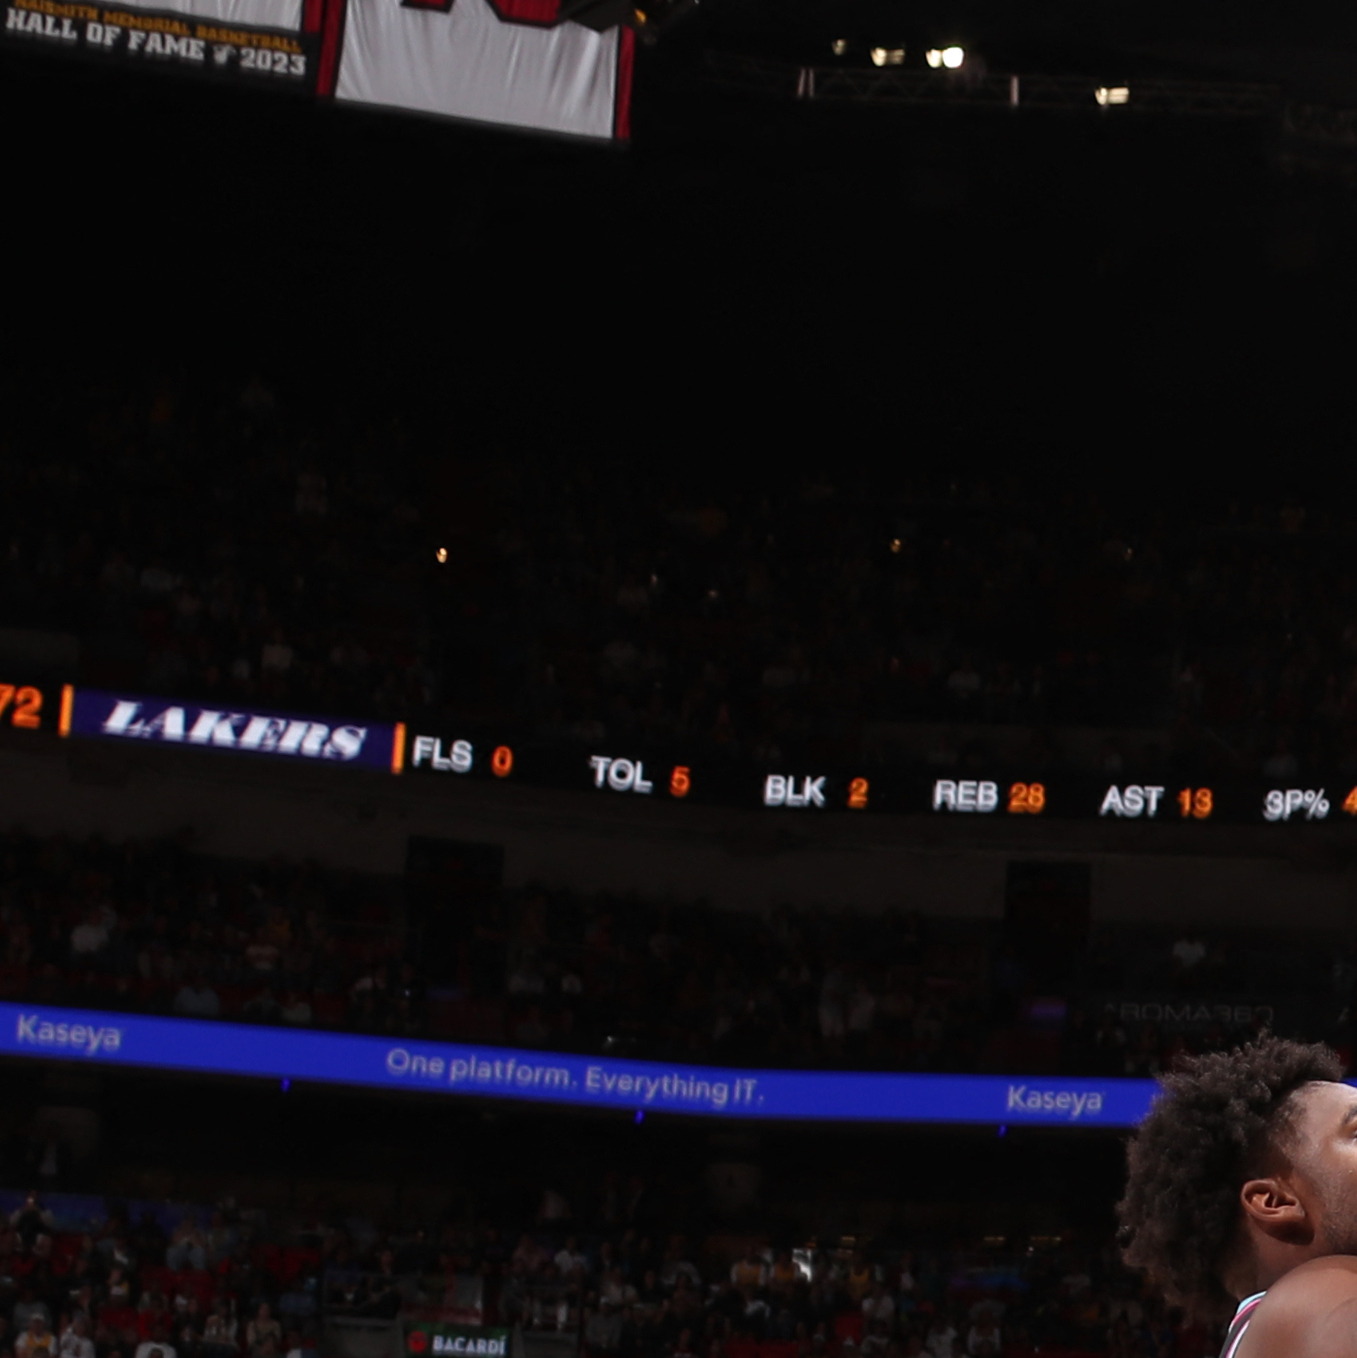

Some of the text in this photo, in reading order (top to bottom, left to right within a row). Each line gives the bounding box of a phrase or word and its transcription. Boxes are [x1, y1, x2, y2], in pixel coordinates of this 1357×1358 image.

[6, 7, 306, 75] HALL OF FAME 2023
[103, 699, 367, 760] LAKERS
[413, 736, 512, 776] FLS 0
[591, 755, 689, 796] TOL 5
[764, 775, 867, 807] BLK 2
[934, 780, 1045, 814] REB 28
[1101, 787, 1163, 817] AST
[17, 1014, 122, 1054] Kaseya
[387, 1047, 444, 1079] One
[450, 1052, 578, 1091] platform.
[586, 1066, 729, 1107] Everything
[1007, 1084, 1102, 1117] Kaseya
[432, 1334, 507, 1356] BACARDÍ
